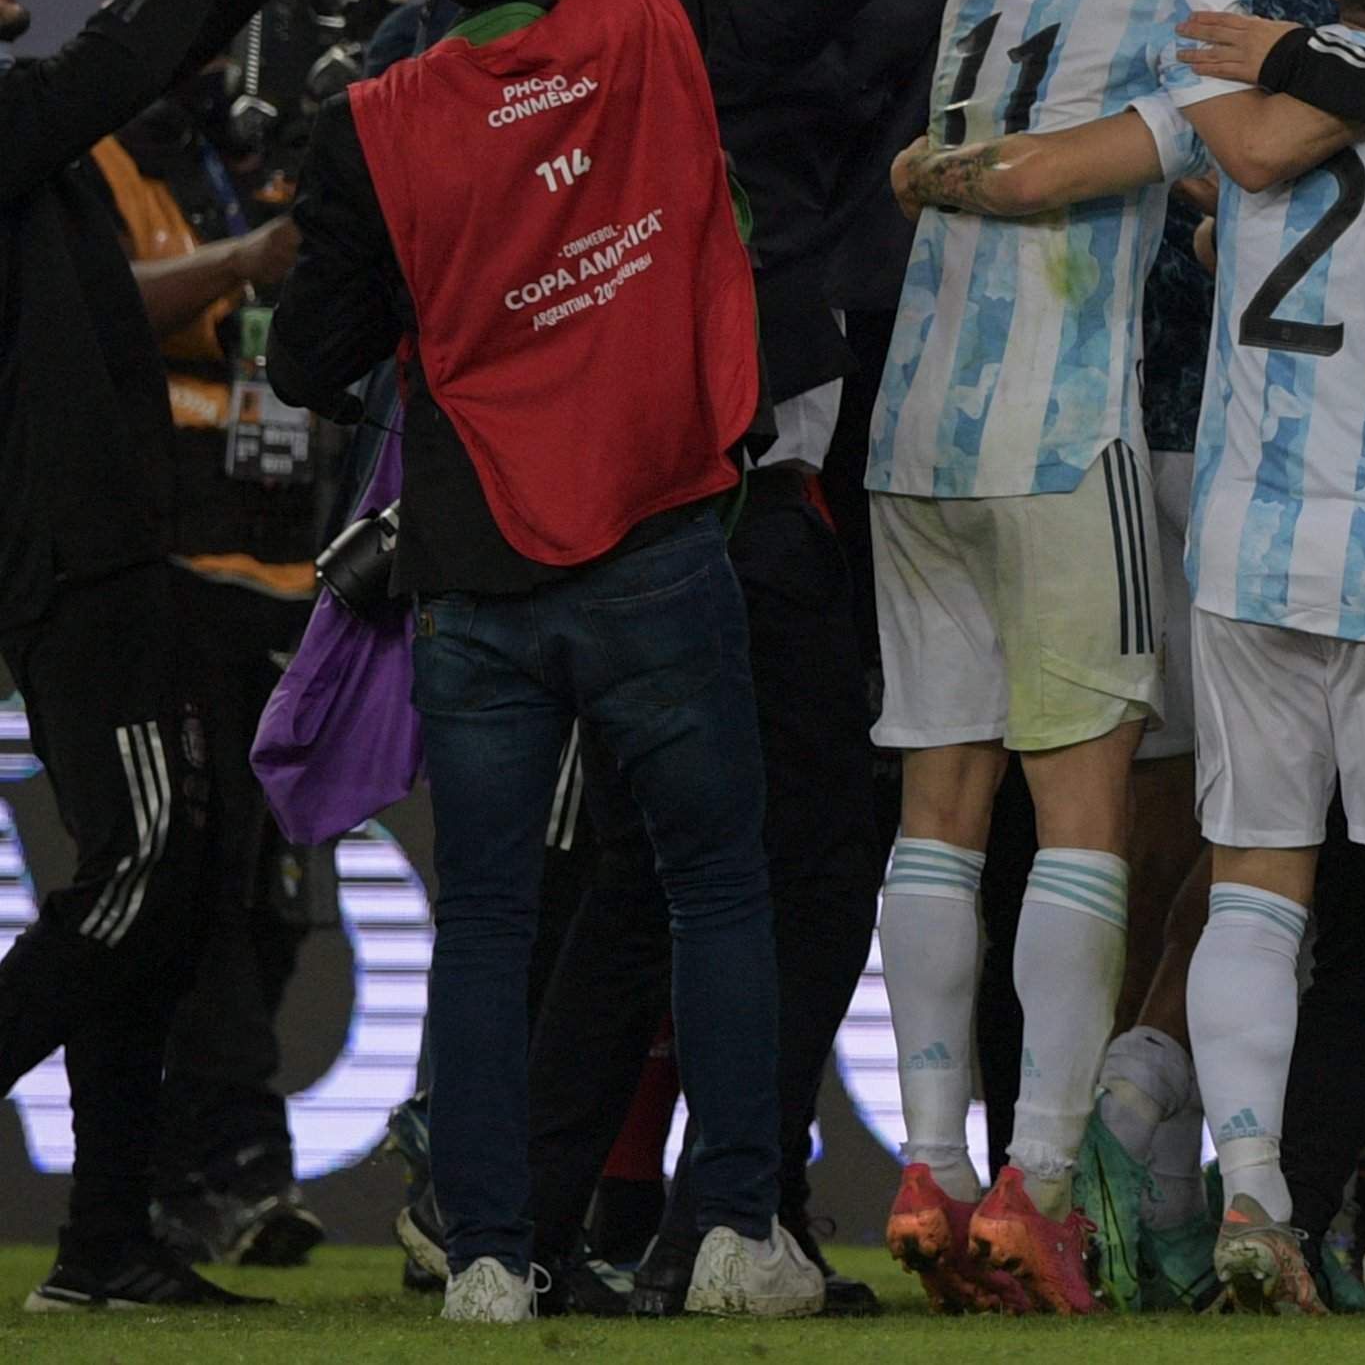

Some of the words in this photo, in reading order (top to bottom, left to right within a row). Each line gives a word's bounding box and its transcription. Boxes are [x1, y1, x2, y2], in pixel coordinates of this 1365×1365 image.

[488, 76, 598, 128] CONMEBOL
[503, 75, 567, 103] PHOTO
[943, 11, 1062, 151] 11
[505, 268, 576, 310] COPA
[532, 293, 594, 331] ARGENTINA
